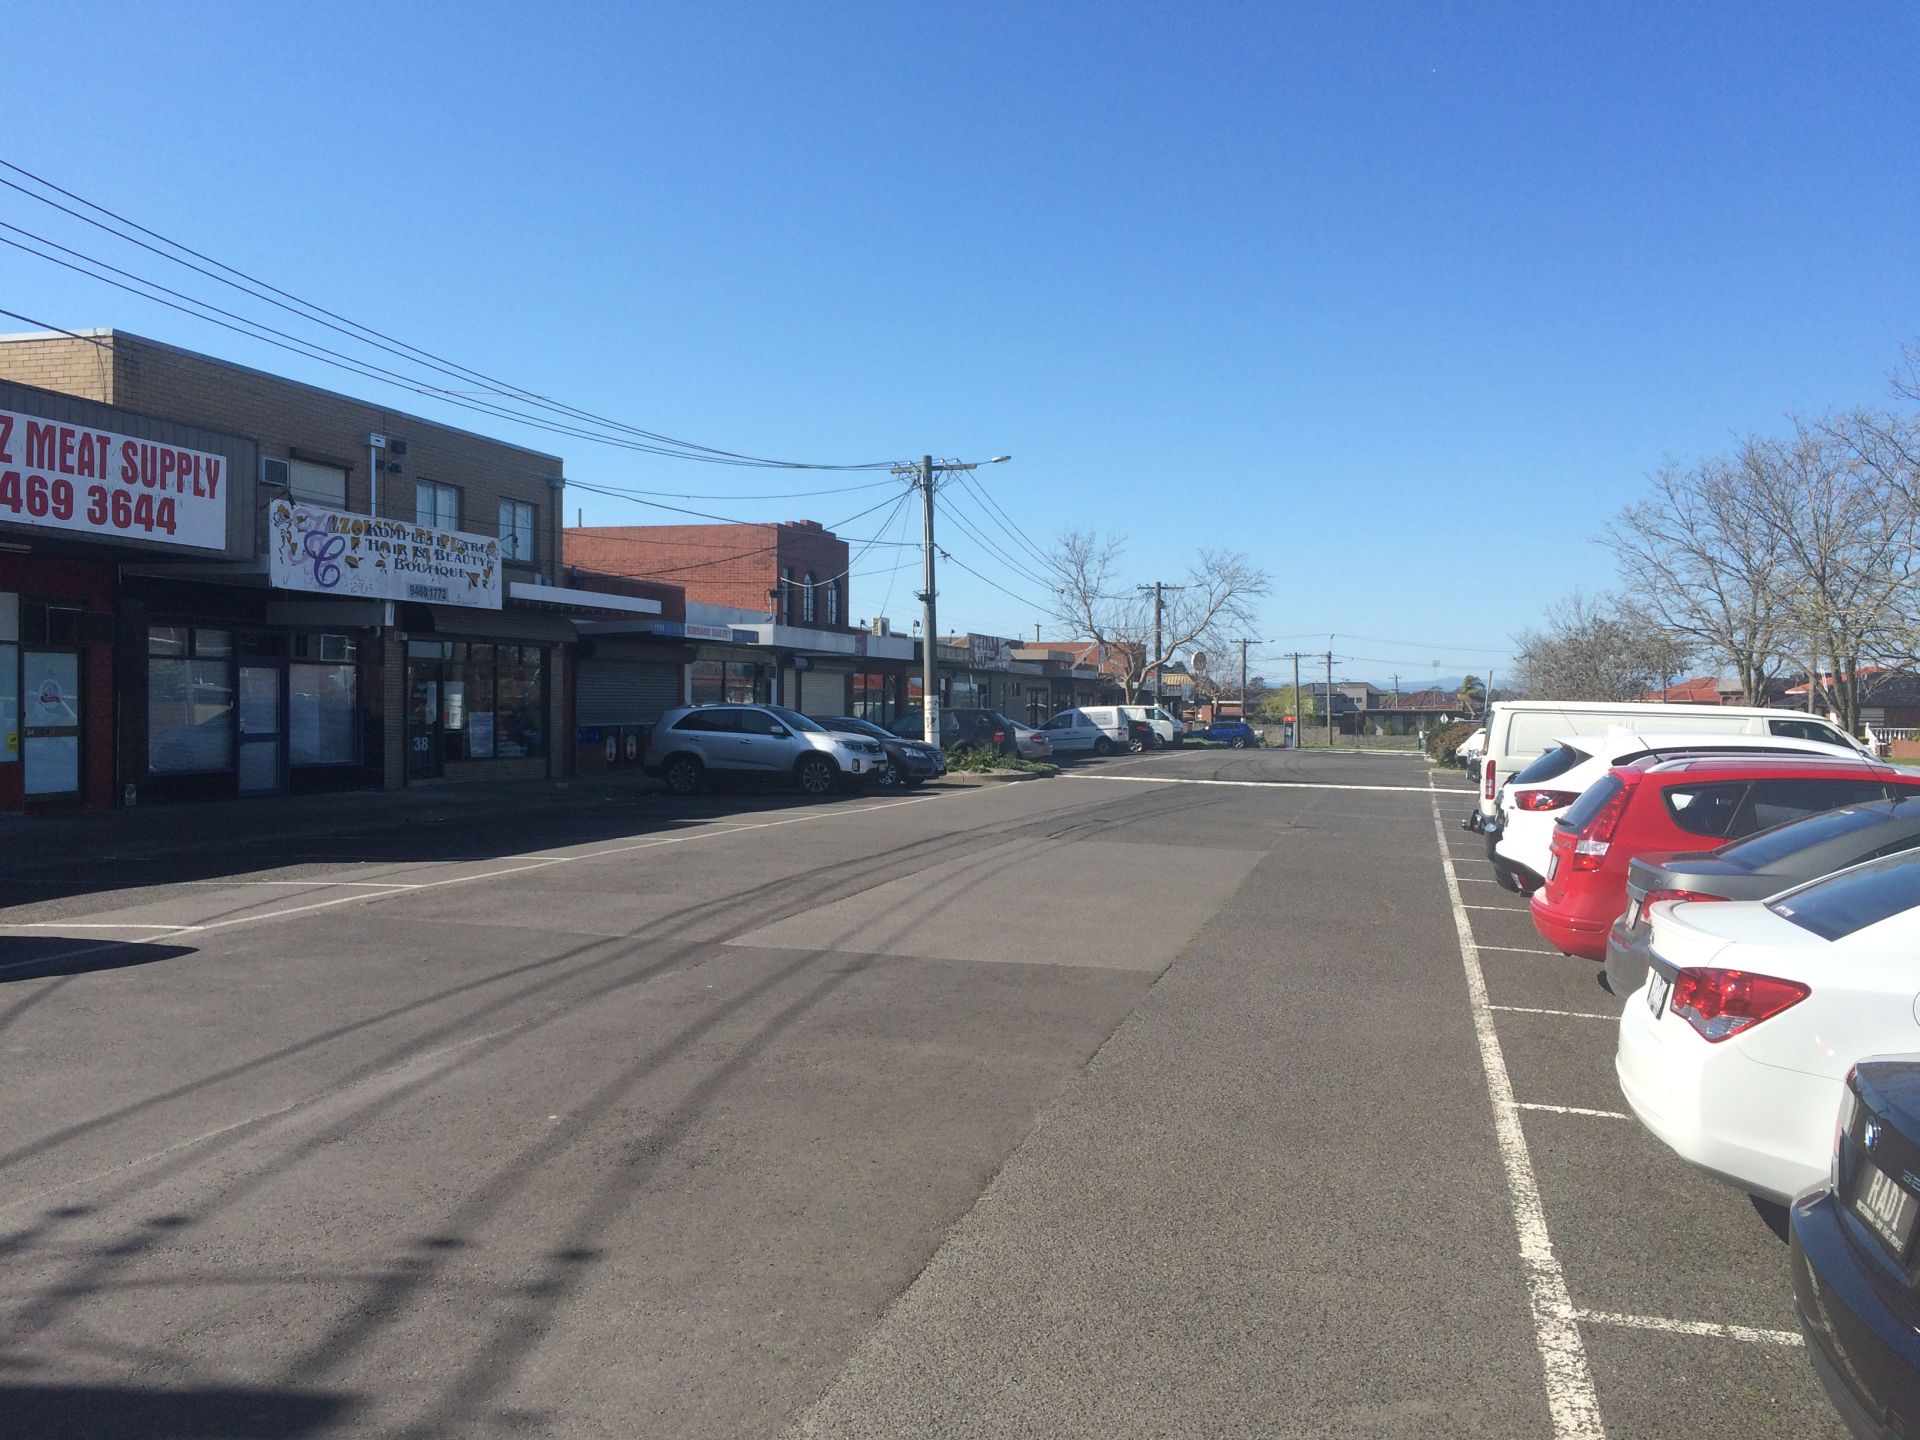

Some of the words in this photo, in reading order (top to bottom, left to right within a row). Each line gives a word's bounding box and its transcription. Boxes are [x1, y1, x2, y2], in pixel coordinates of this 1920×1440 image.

[26, 421, 110, 480] MEAT
[121, 440, 220, 499] SUPPLY
[0, 471, 74, 521] 469
[87, 485, 176, 535] 3644
[394, 557, 467, 578] BOUTIQUE
[435, 548, 488, 567] BEAUTY
[413, 736, 429, 751] 38
